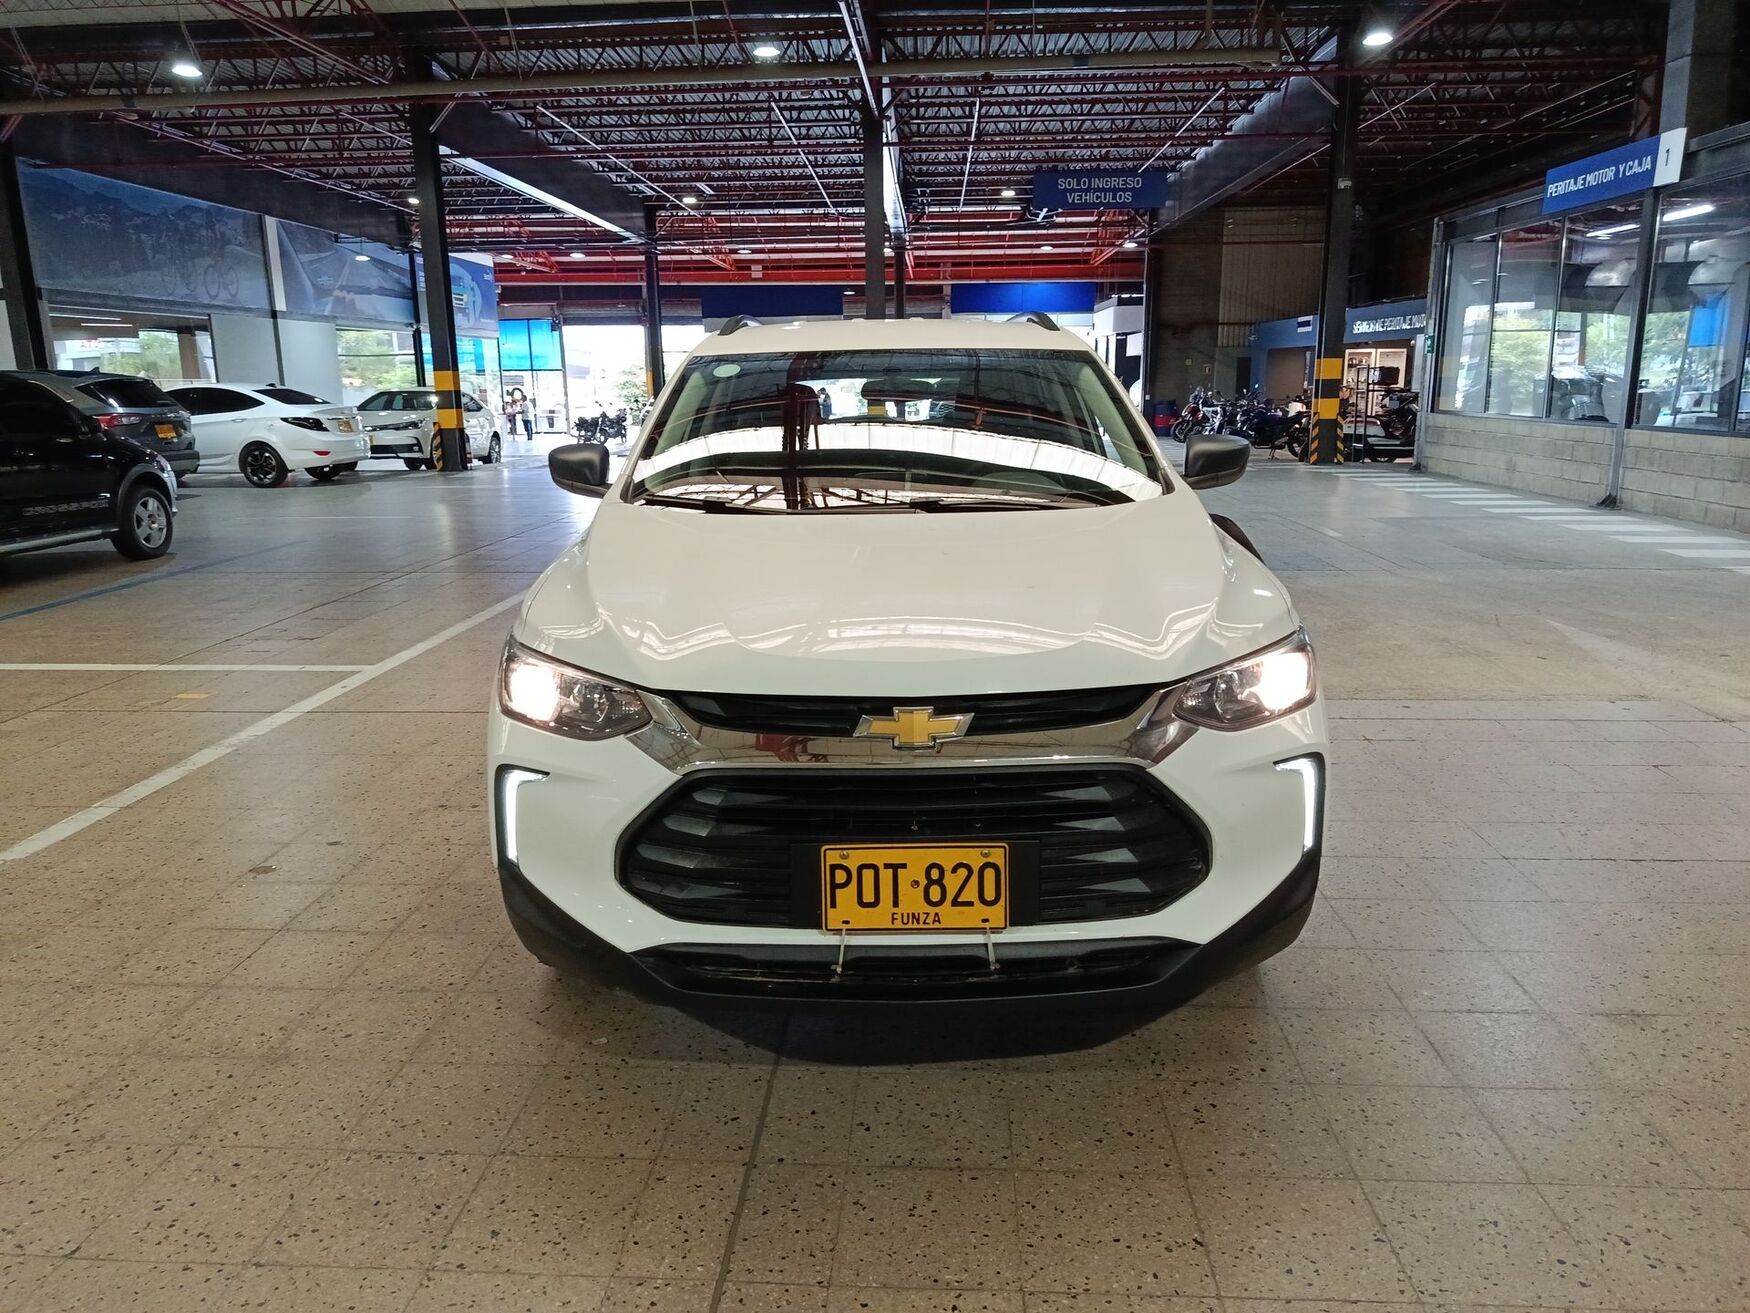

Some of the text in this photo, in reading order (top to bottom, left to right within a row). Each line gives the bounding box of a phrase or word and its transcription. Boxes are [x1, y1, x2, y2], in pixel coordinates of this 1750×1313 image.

[1665, 148, 1671, 167] 1
[1057, 177, 1142, 189] SOLO INGRESO
[1547, 155, 1652, 198] PERITAJE MOTOR Y CAJA
[1066, 190, 1132, 203] VEHÍCULOS
[829, 862, 1002, 909] POT 820
[891, 911, 942, 926] FUNZA
